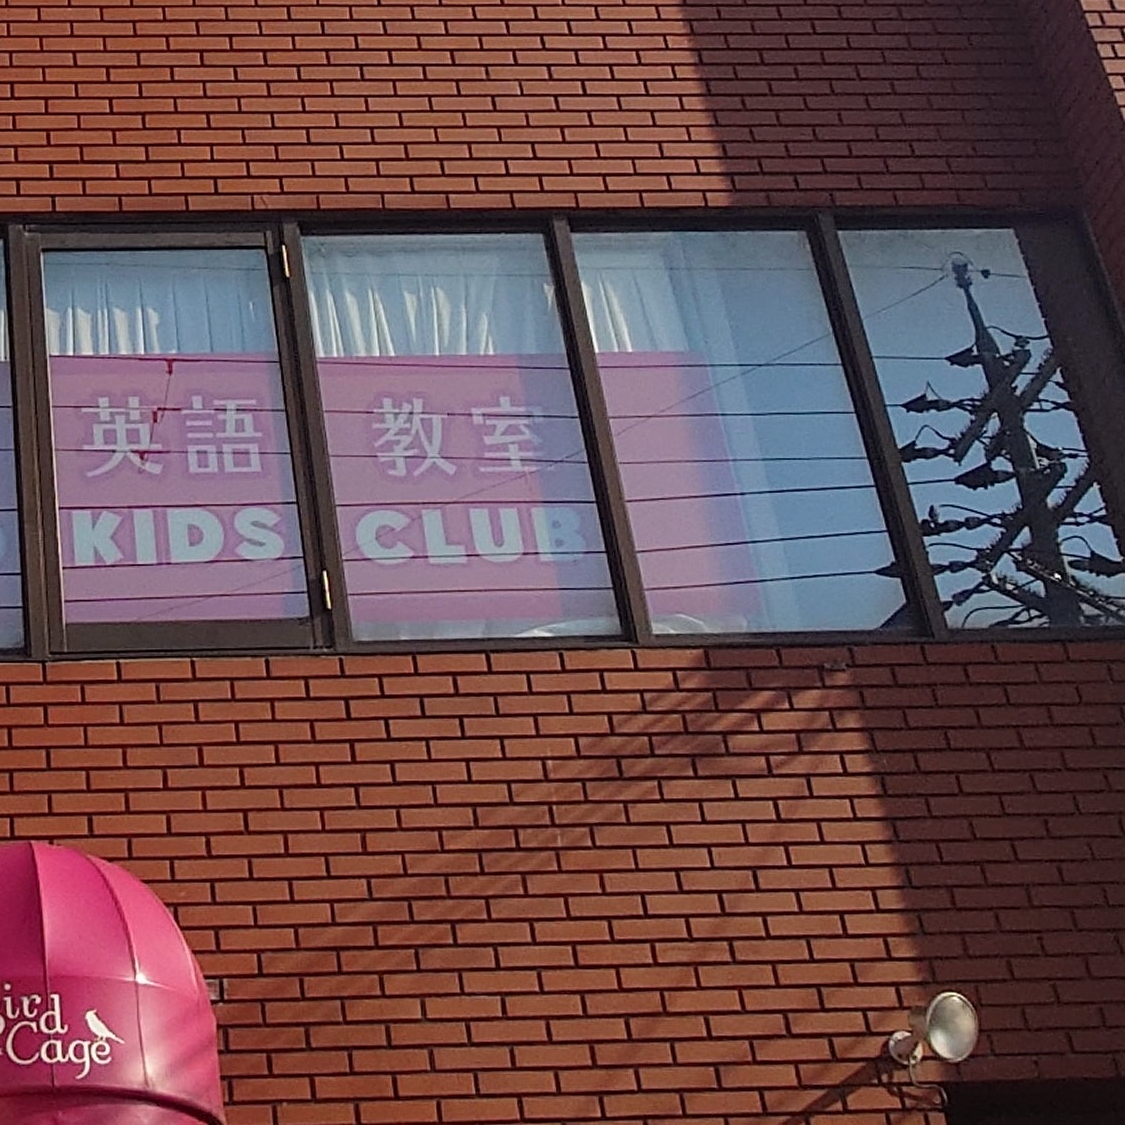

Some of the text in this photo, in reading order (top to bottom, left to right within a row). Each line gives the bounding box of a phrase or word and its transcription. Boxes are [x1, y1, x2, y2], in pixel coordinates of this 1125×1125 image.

[70, 506, 286, 566] KIDS
[355, 505, 588, 566] CLUB
[6, 1021, 112, 1080] Cage
